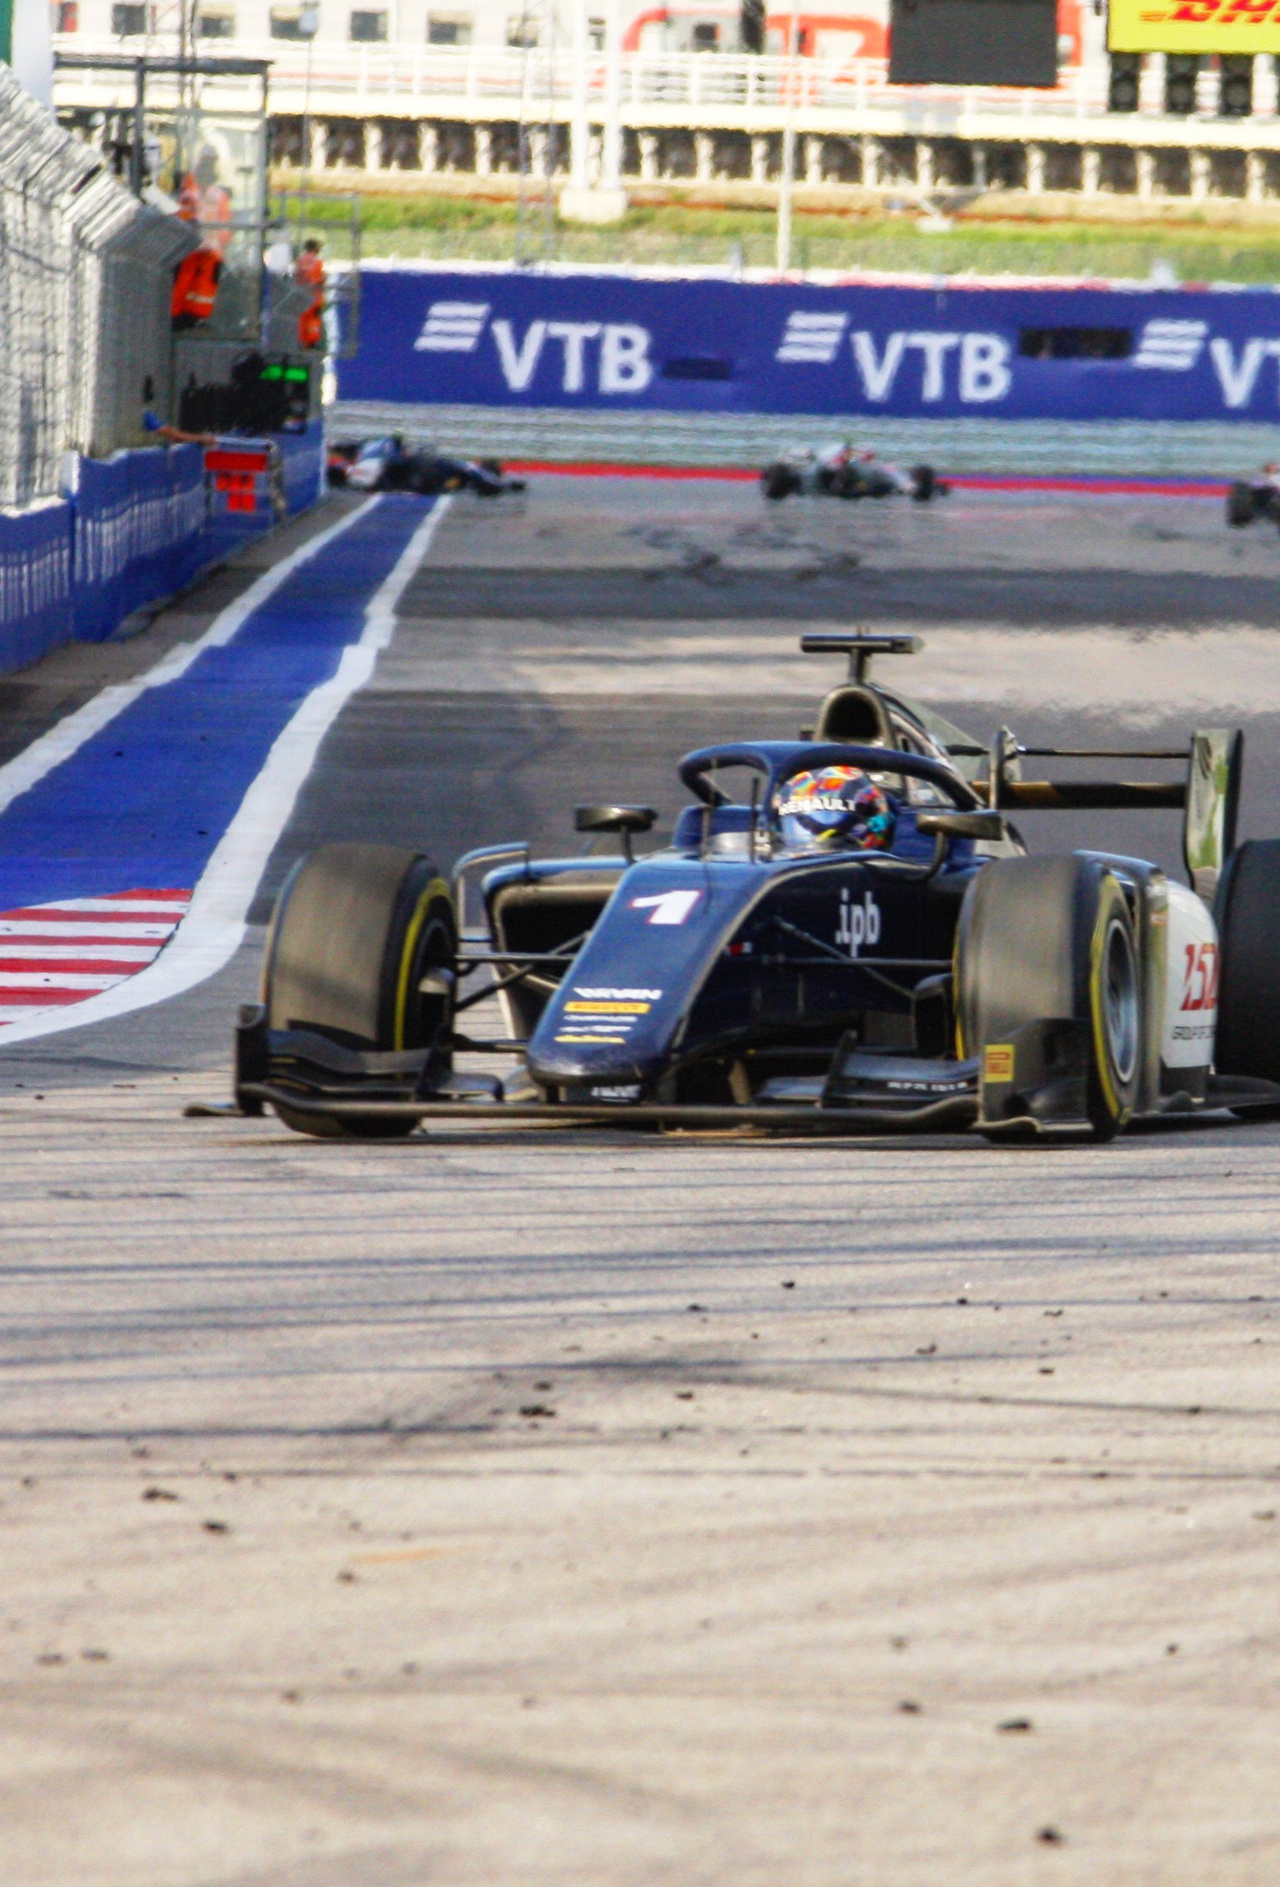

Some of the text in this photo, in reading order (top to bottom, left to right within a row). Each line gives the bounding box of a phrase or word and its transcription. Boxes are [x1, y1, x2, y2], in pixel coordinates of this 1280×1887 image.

[491, 319, 654, 394] VTB
[851, 330, 1012, 404] VTB
[629, 888, 702, 926] 1
